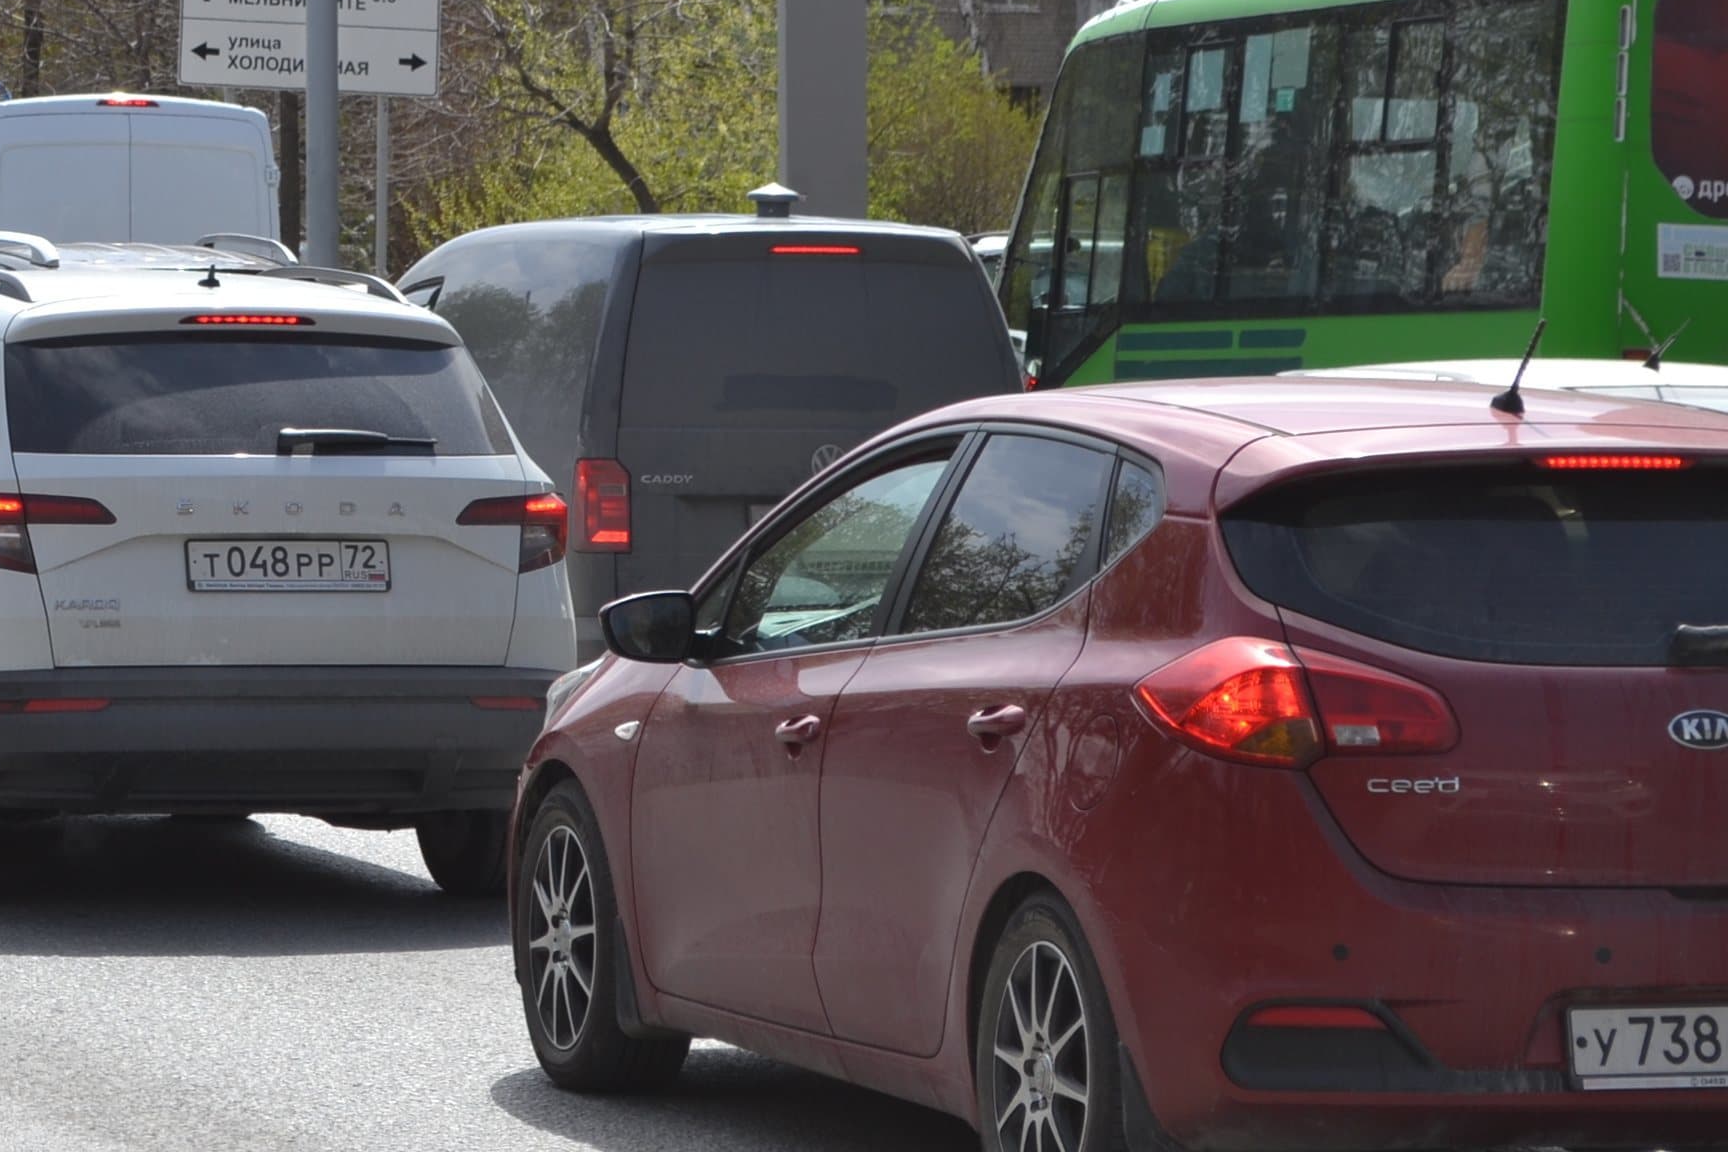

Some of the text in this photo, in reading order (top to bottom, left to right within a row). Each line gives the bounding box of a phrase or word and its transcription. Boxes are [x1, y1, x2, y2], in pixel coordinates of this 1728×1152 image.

[228, 36, 282, 50] улица
[640, 474, 693, 485] CADDY
[344, 545, 376, 569] 72
[344, 570, 368, 579] RUS
